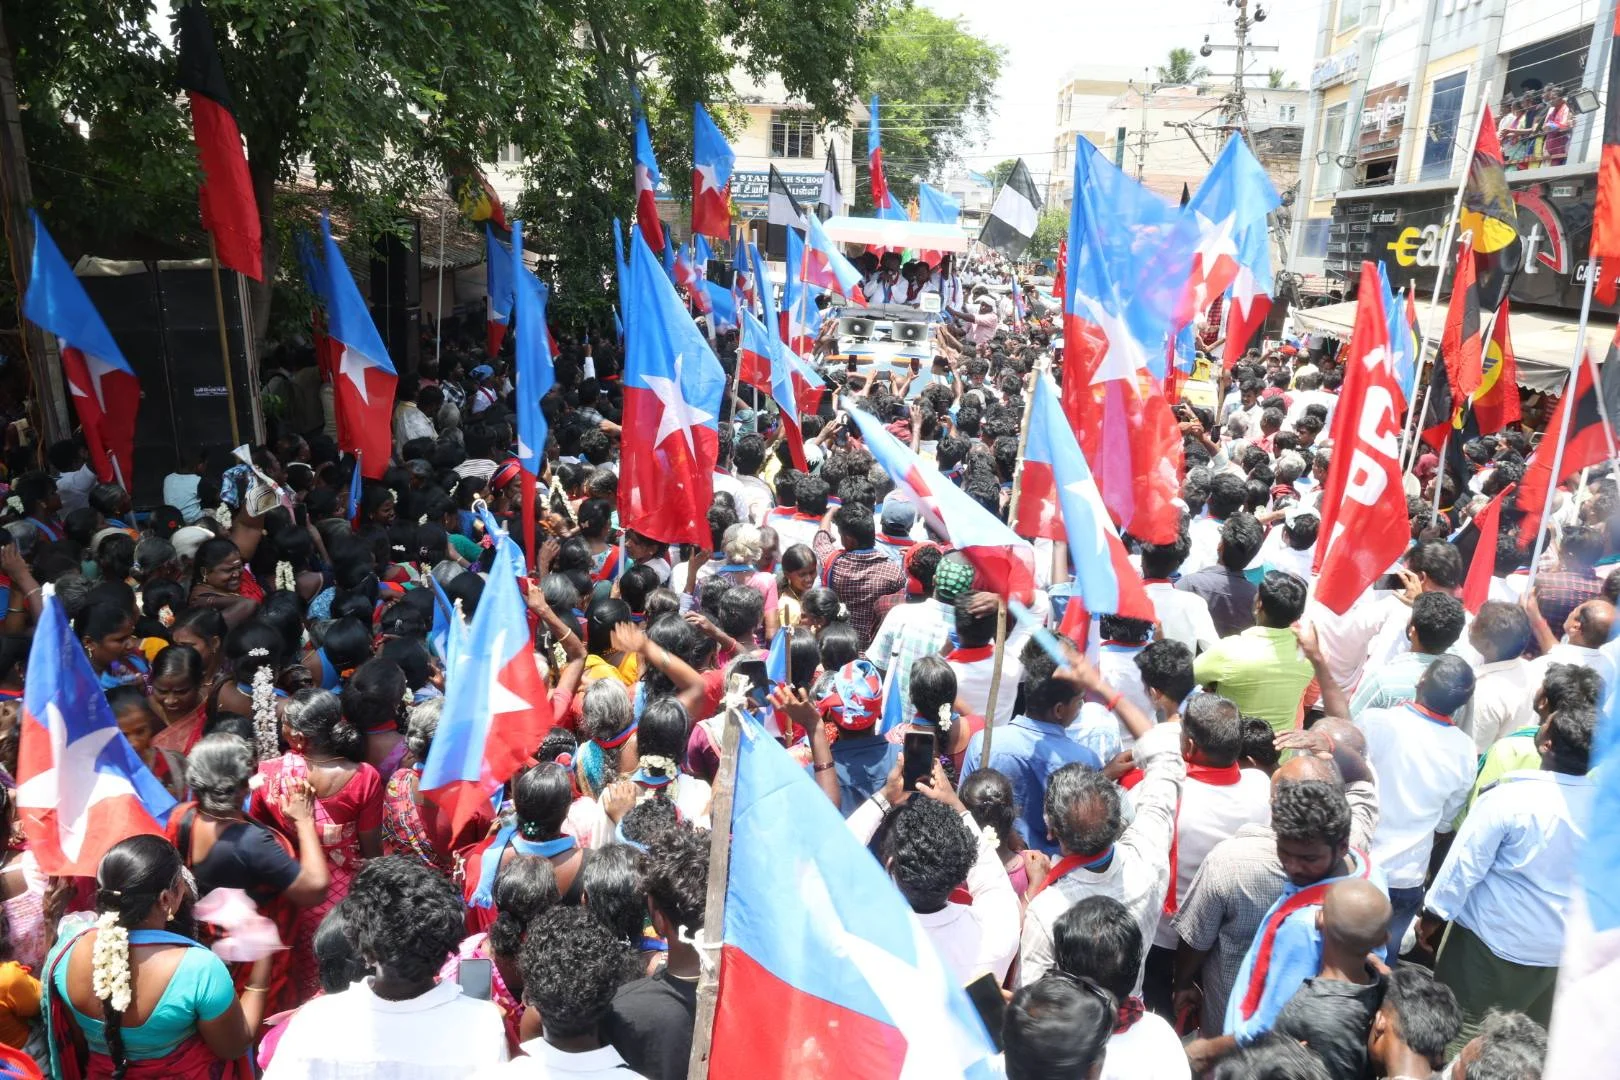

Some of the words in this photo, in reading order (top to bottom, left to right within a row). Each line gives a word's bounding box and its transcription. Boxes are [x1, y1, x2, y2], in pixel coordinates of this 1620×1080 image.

[739, 174, 769, 183] STAR
[795, 176, 824, 184] SCHOO
[1576, 264, 1602, 283] CAE
